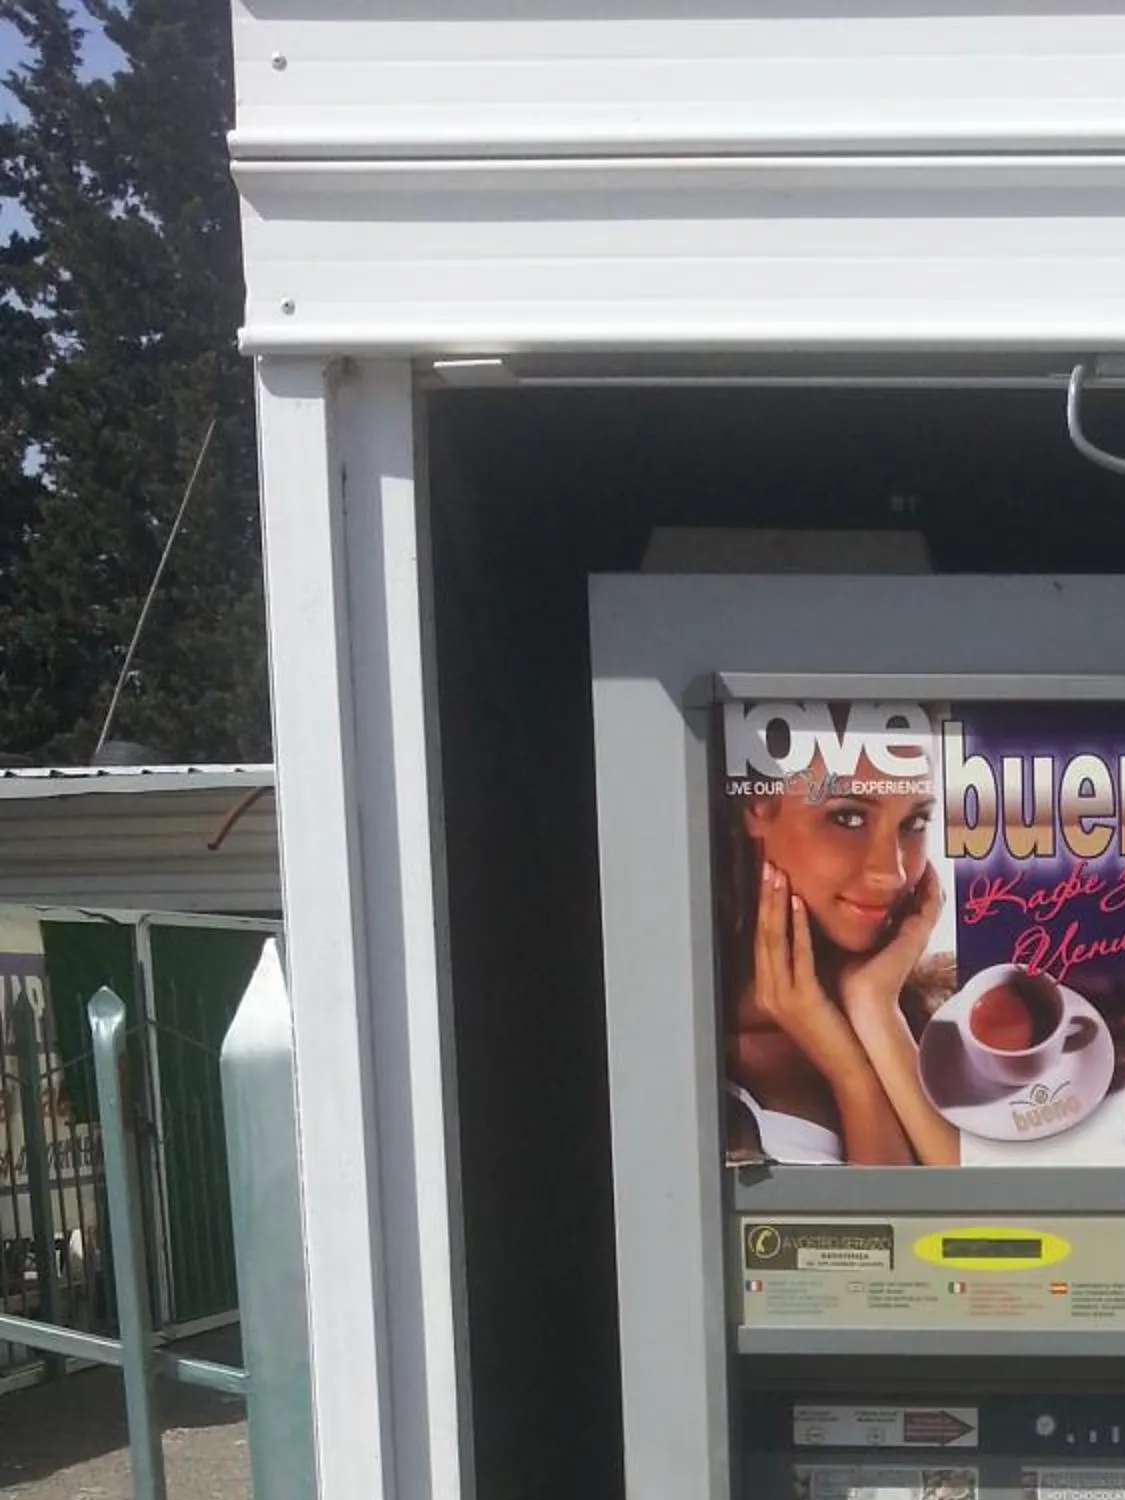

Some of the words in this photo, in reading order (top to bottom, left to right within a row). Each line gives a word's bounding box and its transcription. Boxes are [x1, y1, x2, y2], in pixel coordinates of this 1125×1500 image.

[725, 781, 752, 795] LIVE
[753, 781, 785, 795] OUR
[851, 781, 933, 795] EXPERIENCE
[1011, 1096, 1082, 1132] bueno
